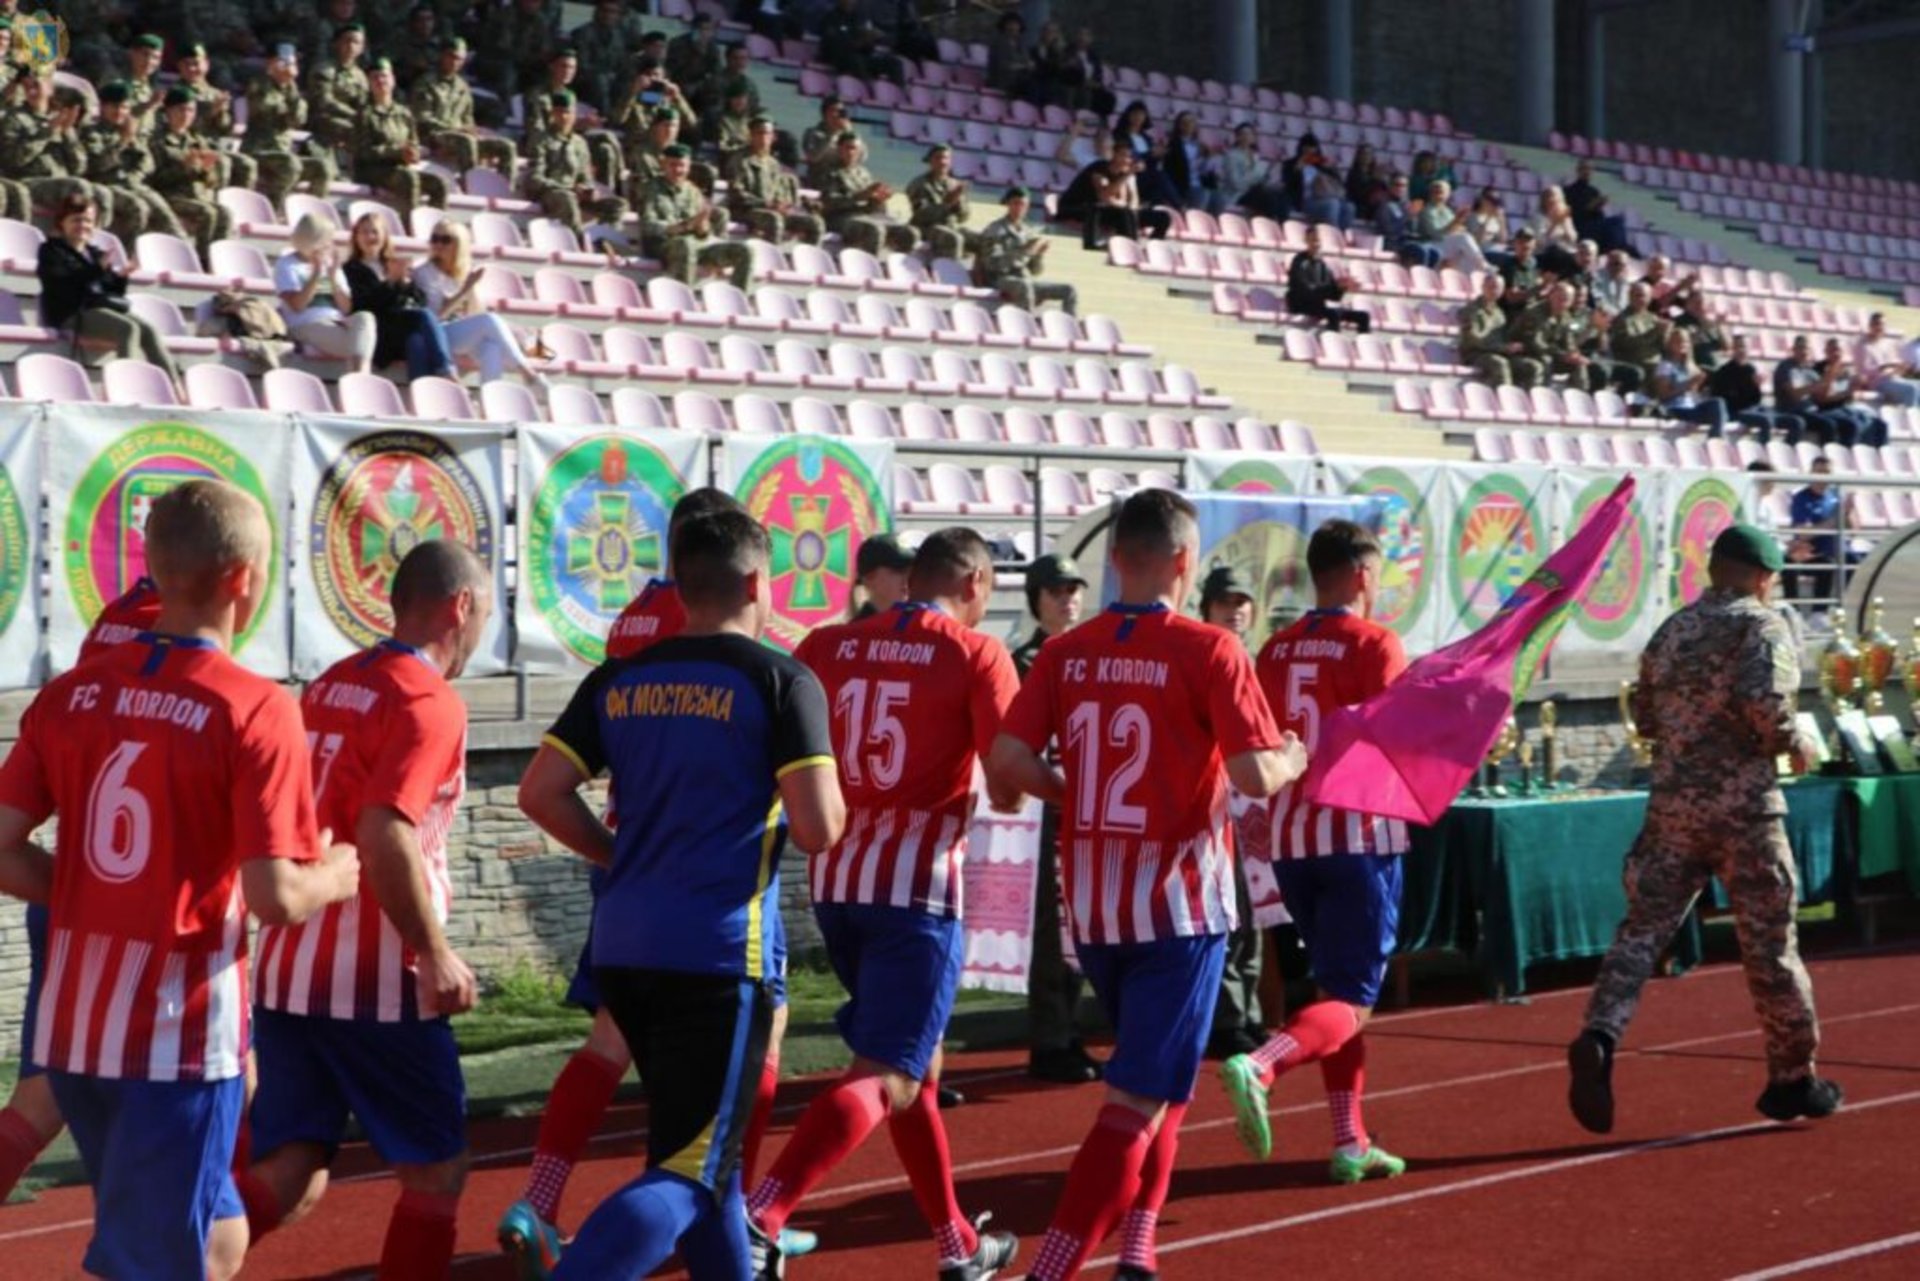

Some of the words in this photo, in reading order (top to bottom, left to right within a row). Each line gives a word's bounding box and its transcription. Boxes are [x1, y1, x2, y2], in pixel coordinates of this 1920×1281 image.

[109, 430, 236, 470] ДЕРЖАВНА
[836, 638, 859, 661] FC
[866, 638, 936, 667] KORDON
[1271, 642, 1290, 660] FC
[1293, 639, 1347, 661] KORDON
[1063, 657, 1088, 683] FC
[1096, 656, 1169, 688] KORDON
[69, 683, 101, 713] FC
[114, 687, 212, 733] KORDON
[322, 681, 380, 715] KORDON
[606, 685, 632, 721] ФК
[632, 683, 735, 722] МОСТИСЬКА
[1285, 663, 1320, 760] 5
[834, 677, 911, 791] 15
[1066, 700, 1152, 835] 12
[83, 740, 149, 885] 6
